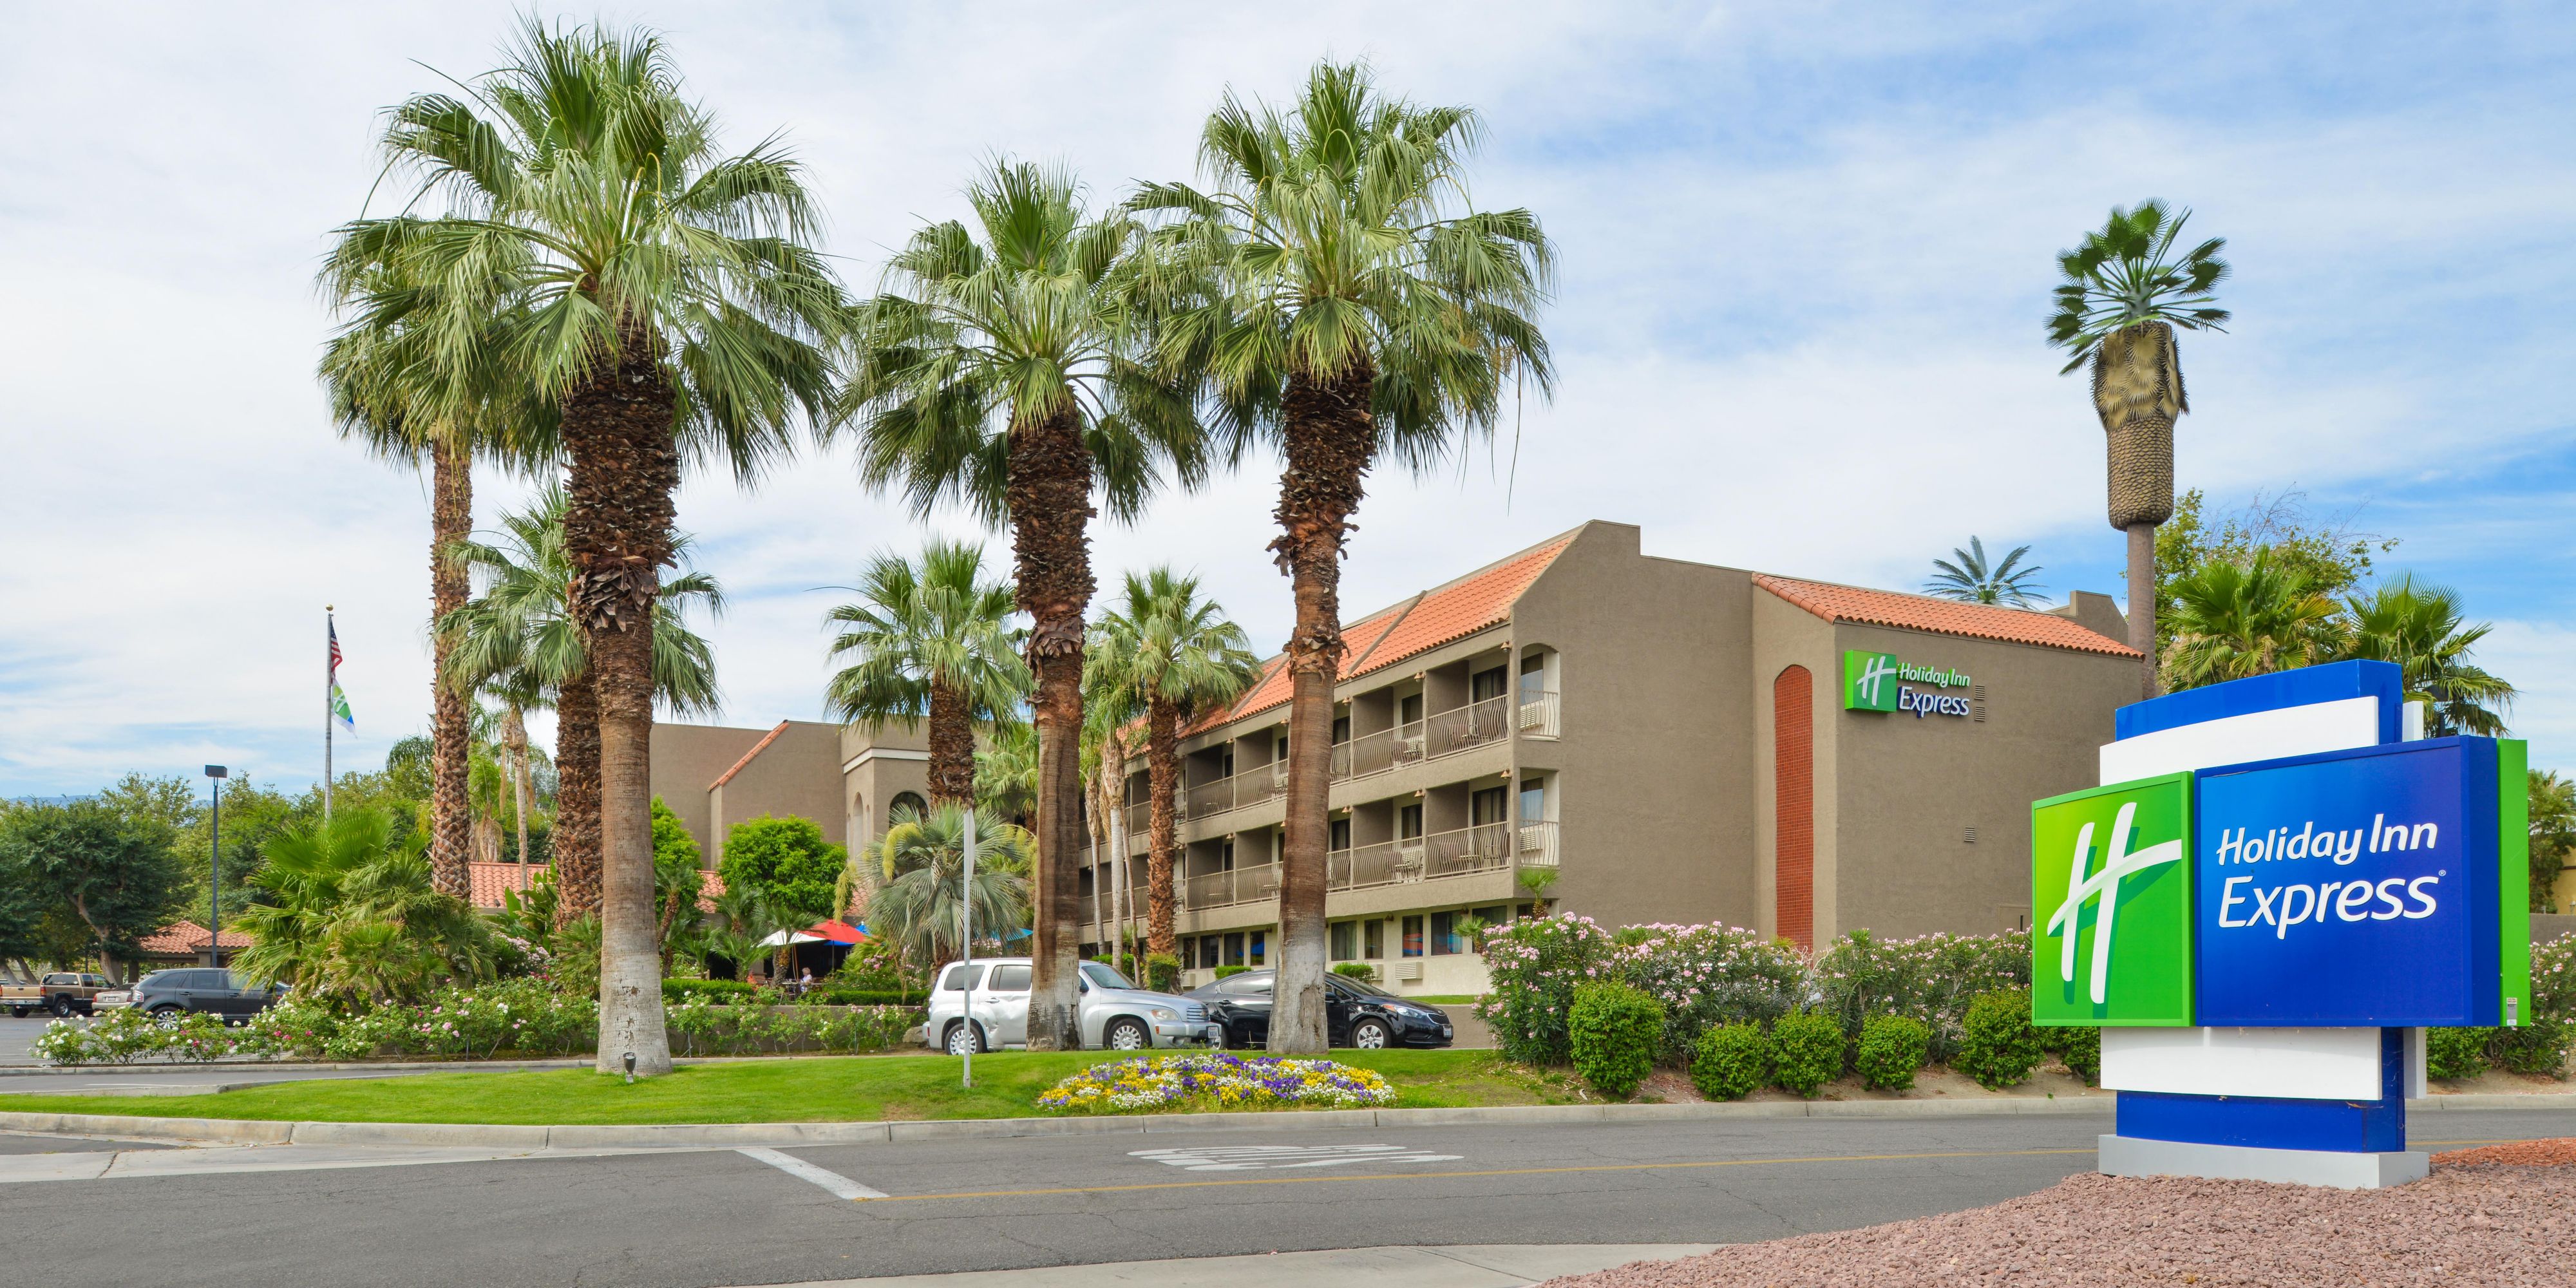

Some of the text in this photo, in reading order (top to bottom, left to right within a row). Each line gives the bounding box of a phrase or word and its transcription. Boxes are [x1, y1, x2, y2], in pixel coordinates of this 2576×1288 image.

[1899, 662, 1971, 688] Holiday Inn
[1899, 686, 1971, 718] Express
[2216, 813, 2438, 866] Holiday Inn
